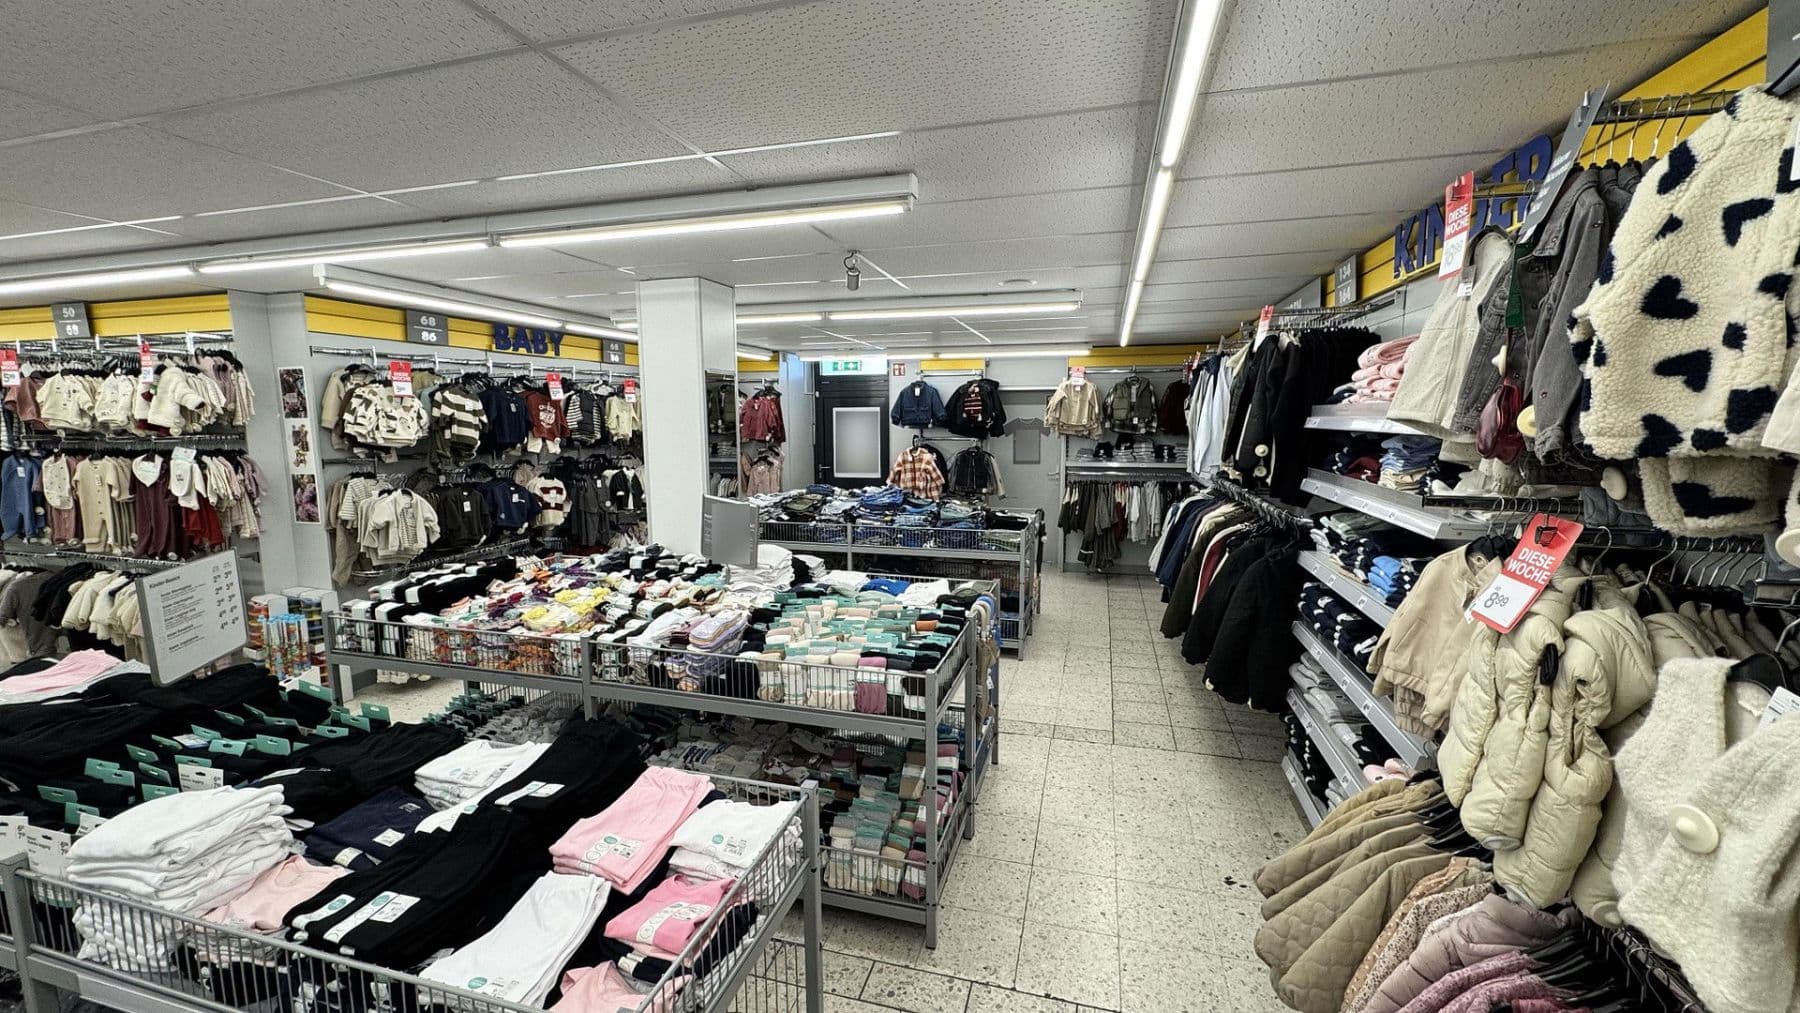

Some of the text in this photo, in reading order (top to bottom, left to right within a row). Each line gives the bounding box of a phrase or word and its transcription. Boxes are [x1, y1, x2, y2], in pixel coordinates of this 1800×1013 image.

[1448, 203, 1469, 223] DIESE
[62, 307, 75, 318] 50
[420, 315, 436, 327] 68
[421, 331, 437, 342] 86
[494, 322, 565, 356] BABY
[1518, 547, 1556, 570] DIESE
[1507, 558, 1551, 585] WOCHE
